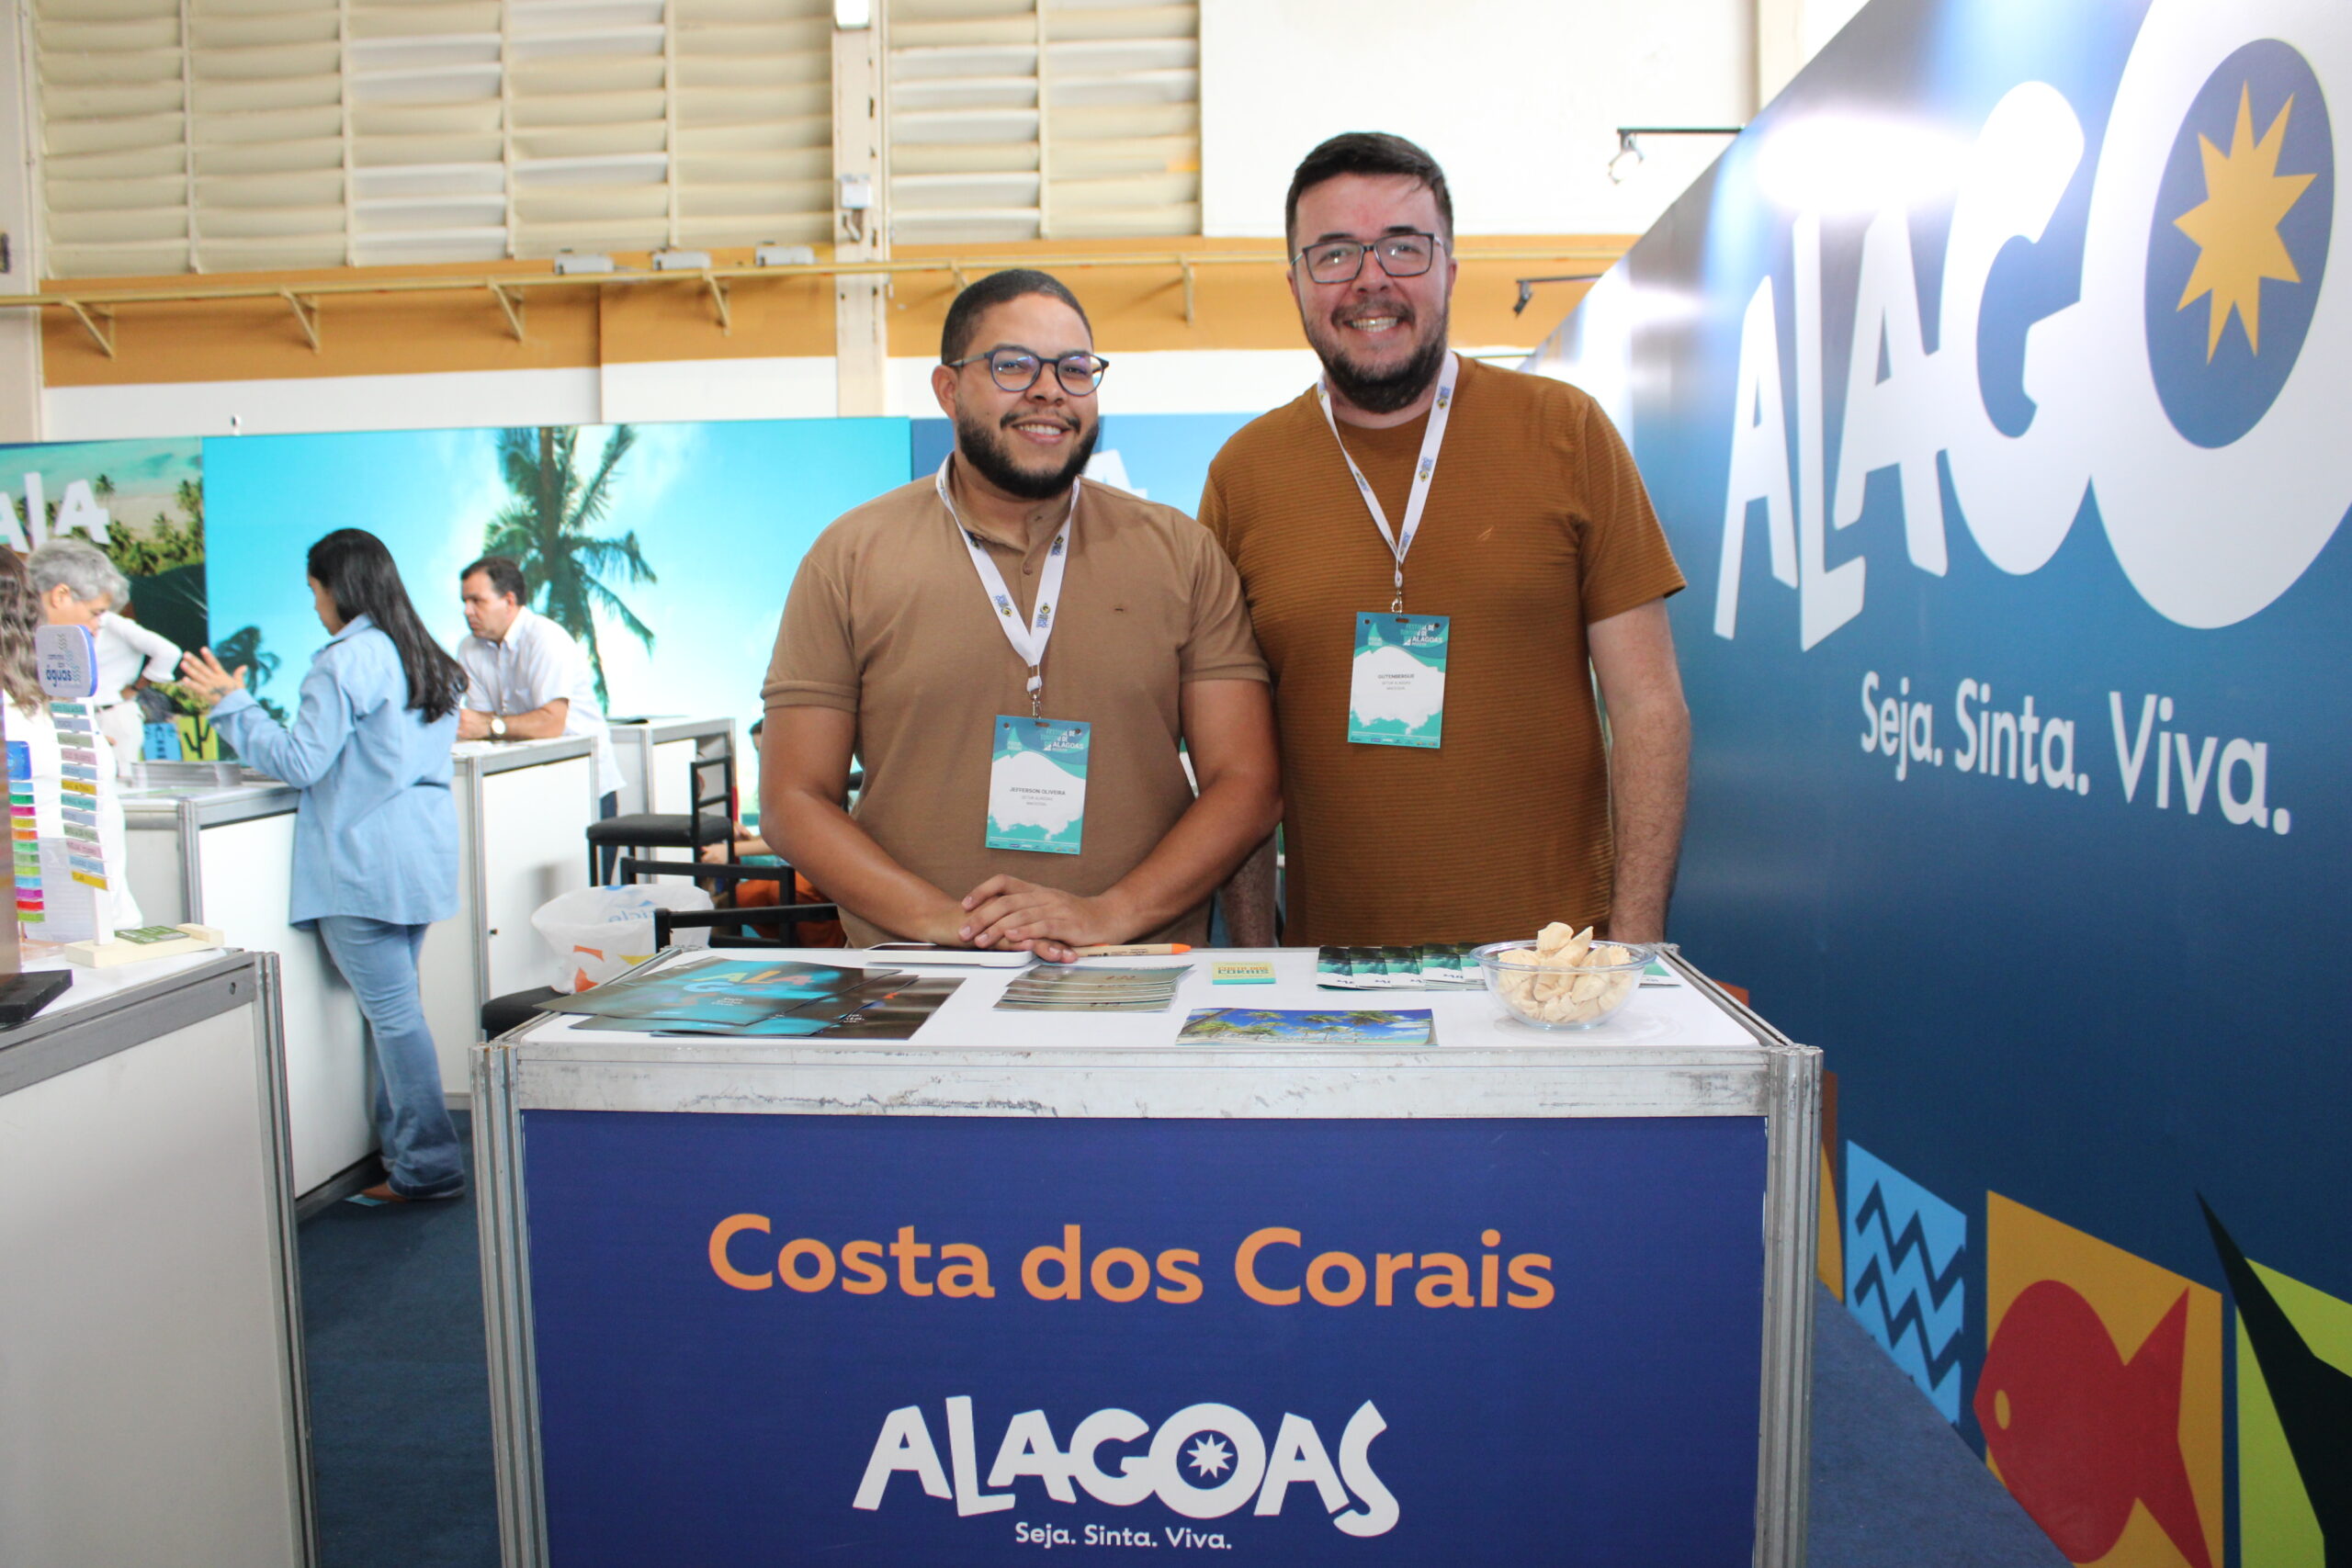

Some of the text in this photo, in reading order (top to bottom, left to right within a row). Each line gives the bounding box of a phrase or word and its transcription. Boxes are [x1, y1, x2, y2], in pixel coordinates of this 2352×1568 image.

[1861, 671, 2291, 835] Seja. Sinta. Viva.
[707, 1213, 1555, 1309] Costa dos Corais
[852, 1395, 1400, 1538] ALAGOAS
[1014, 1520, 1233, 1551] Seja. Sinta. Viva.
